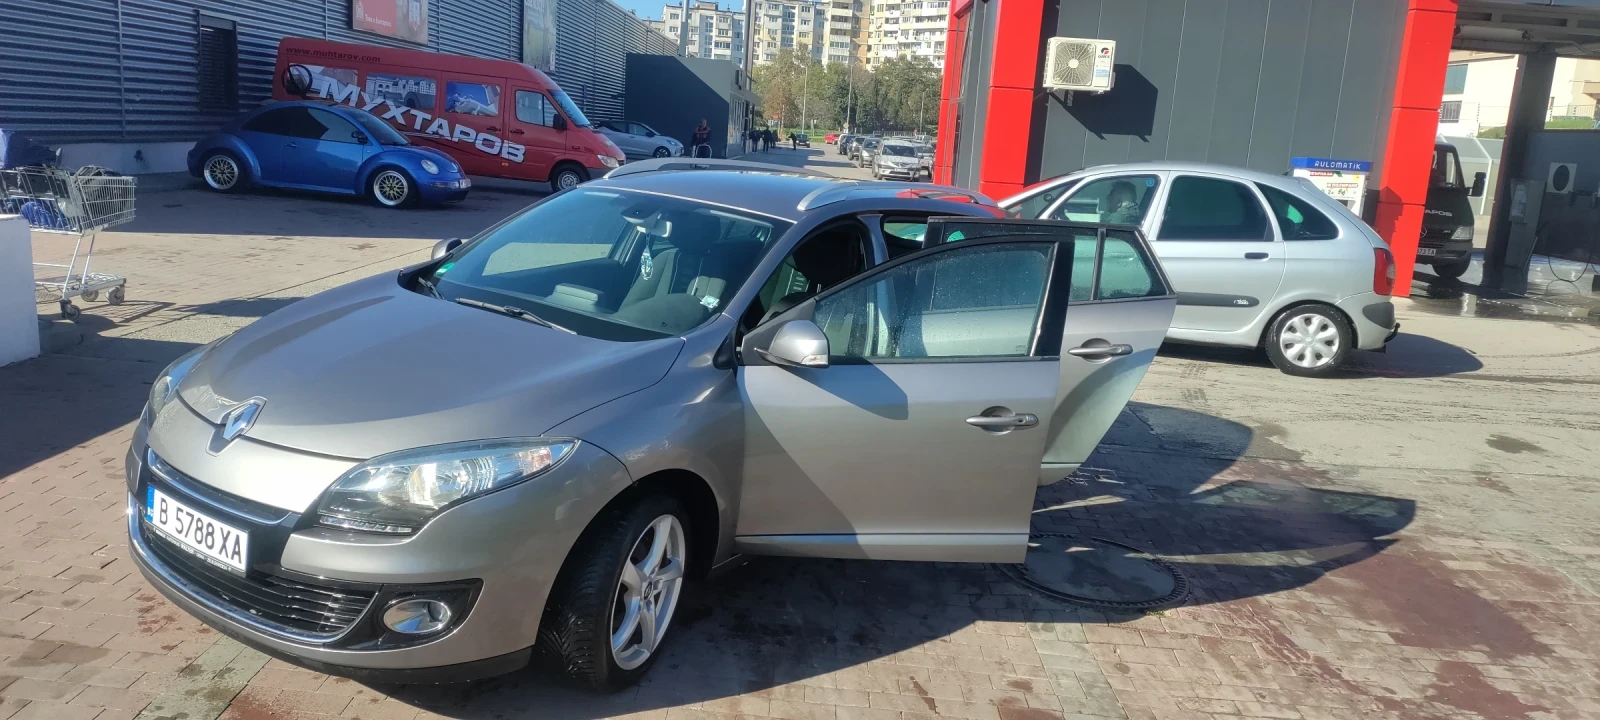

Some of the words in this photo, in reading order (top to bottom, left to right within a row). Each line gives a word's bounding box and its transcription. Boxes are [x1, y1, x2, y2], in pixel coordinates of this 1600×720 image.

[285, 46, 380, 62] www.muhtarov.com
[319, 80, 526, 163] МУХТАРОВ
[159, 497, 168, 526] B
[175, 506, 215, 550] 5788
[218, 527, 242, 564] XA
